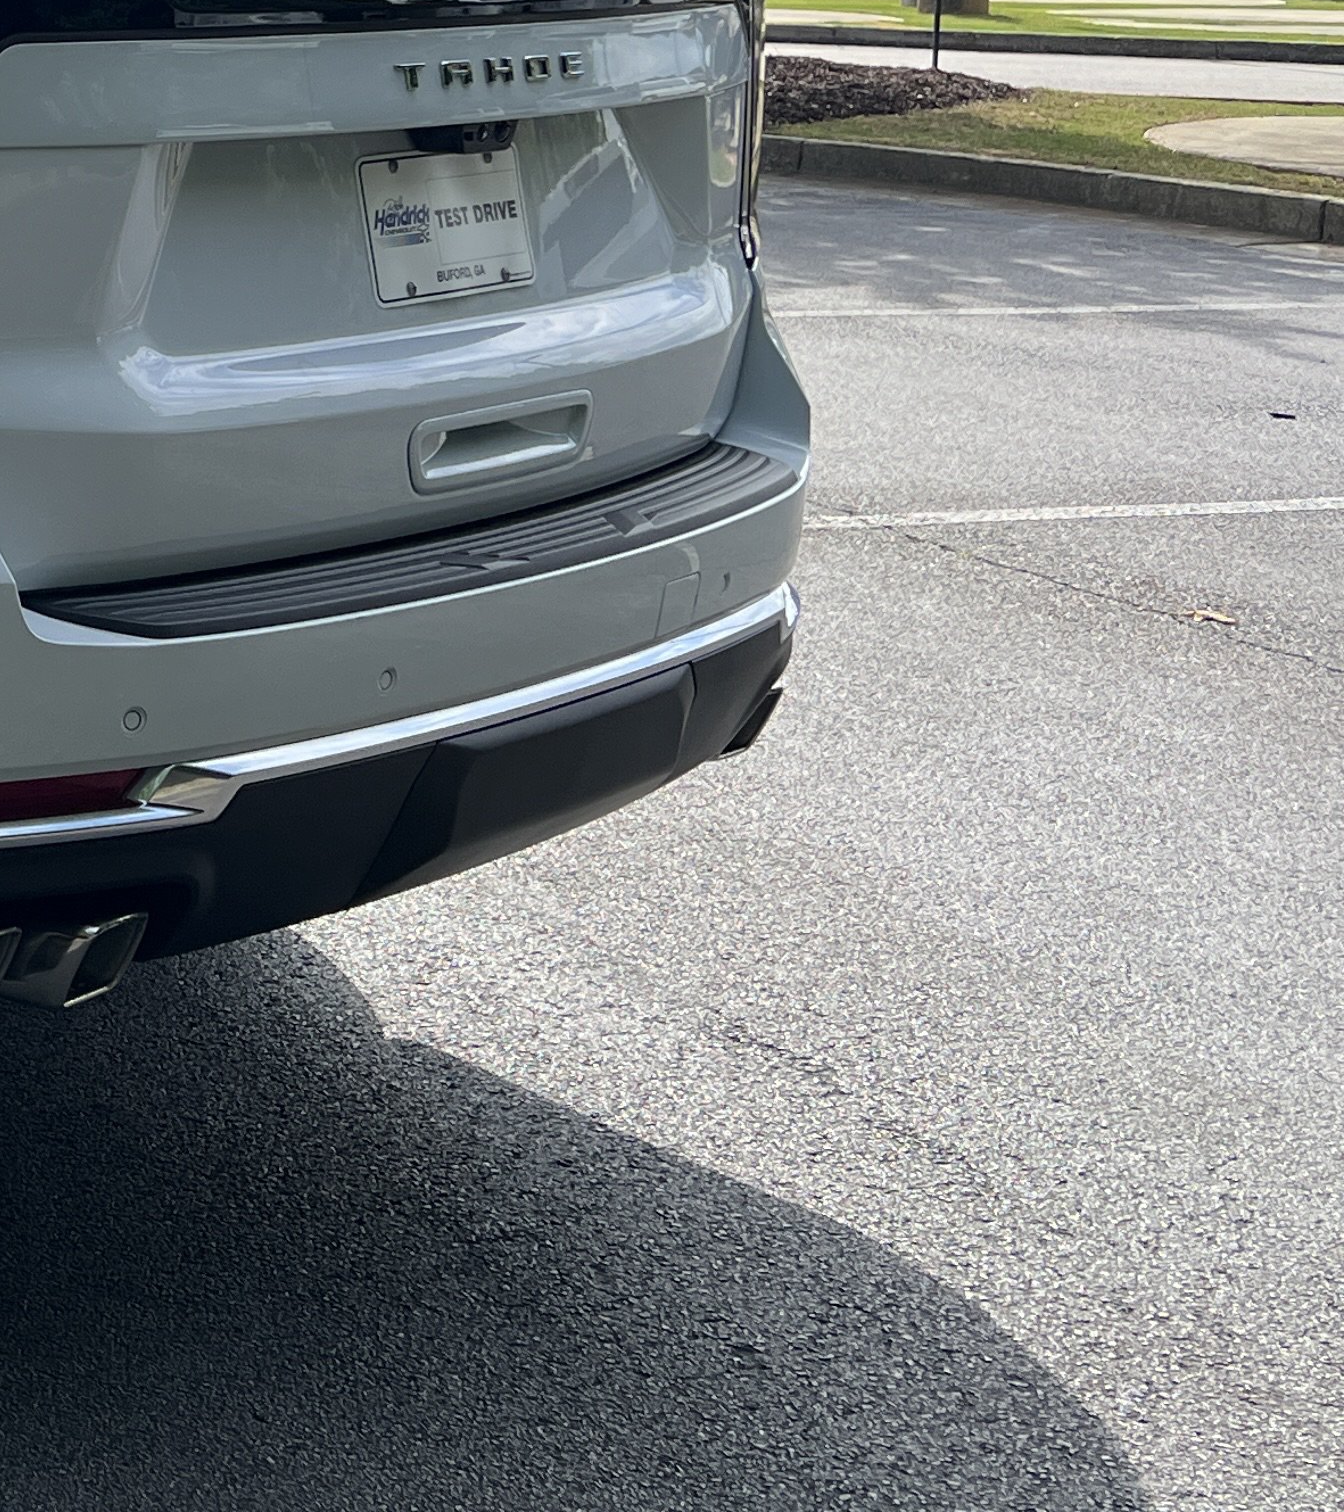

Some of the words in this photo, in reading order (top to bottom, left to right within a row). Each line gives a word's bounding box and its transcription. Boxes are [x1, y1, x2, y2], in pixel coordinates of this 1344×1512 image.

[393, 51, 585, 92] TAHOE
[373, 202, 430, 236] Hendrick
[434, 206, 469, 229] TEST
[474, 200, 518, 224] DRIVE
[436, 266, 474, 283] BUFORD,
[473, 264, 486, 277] GA
